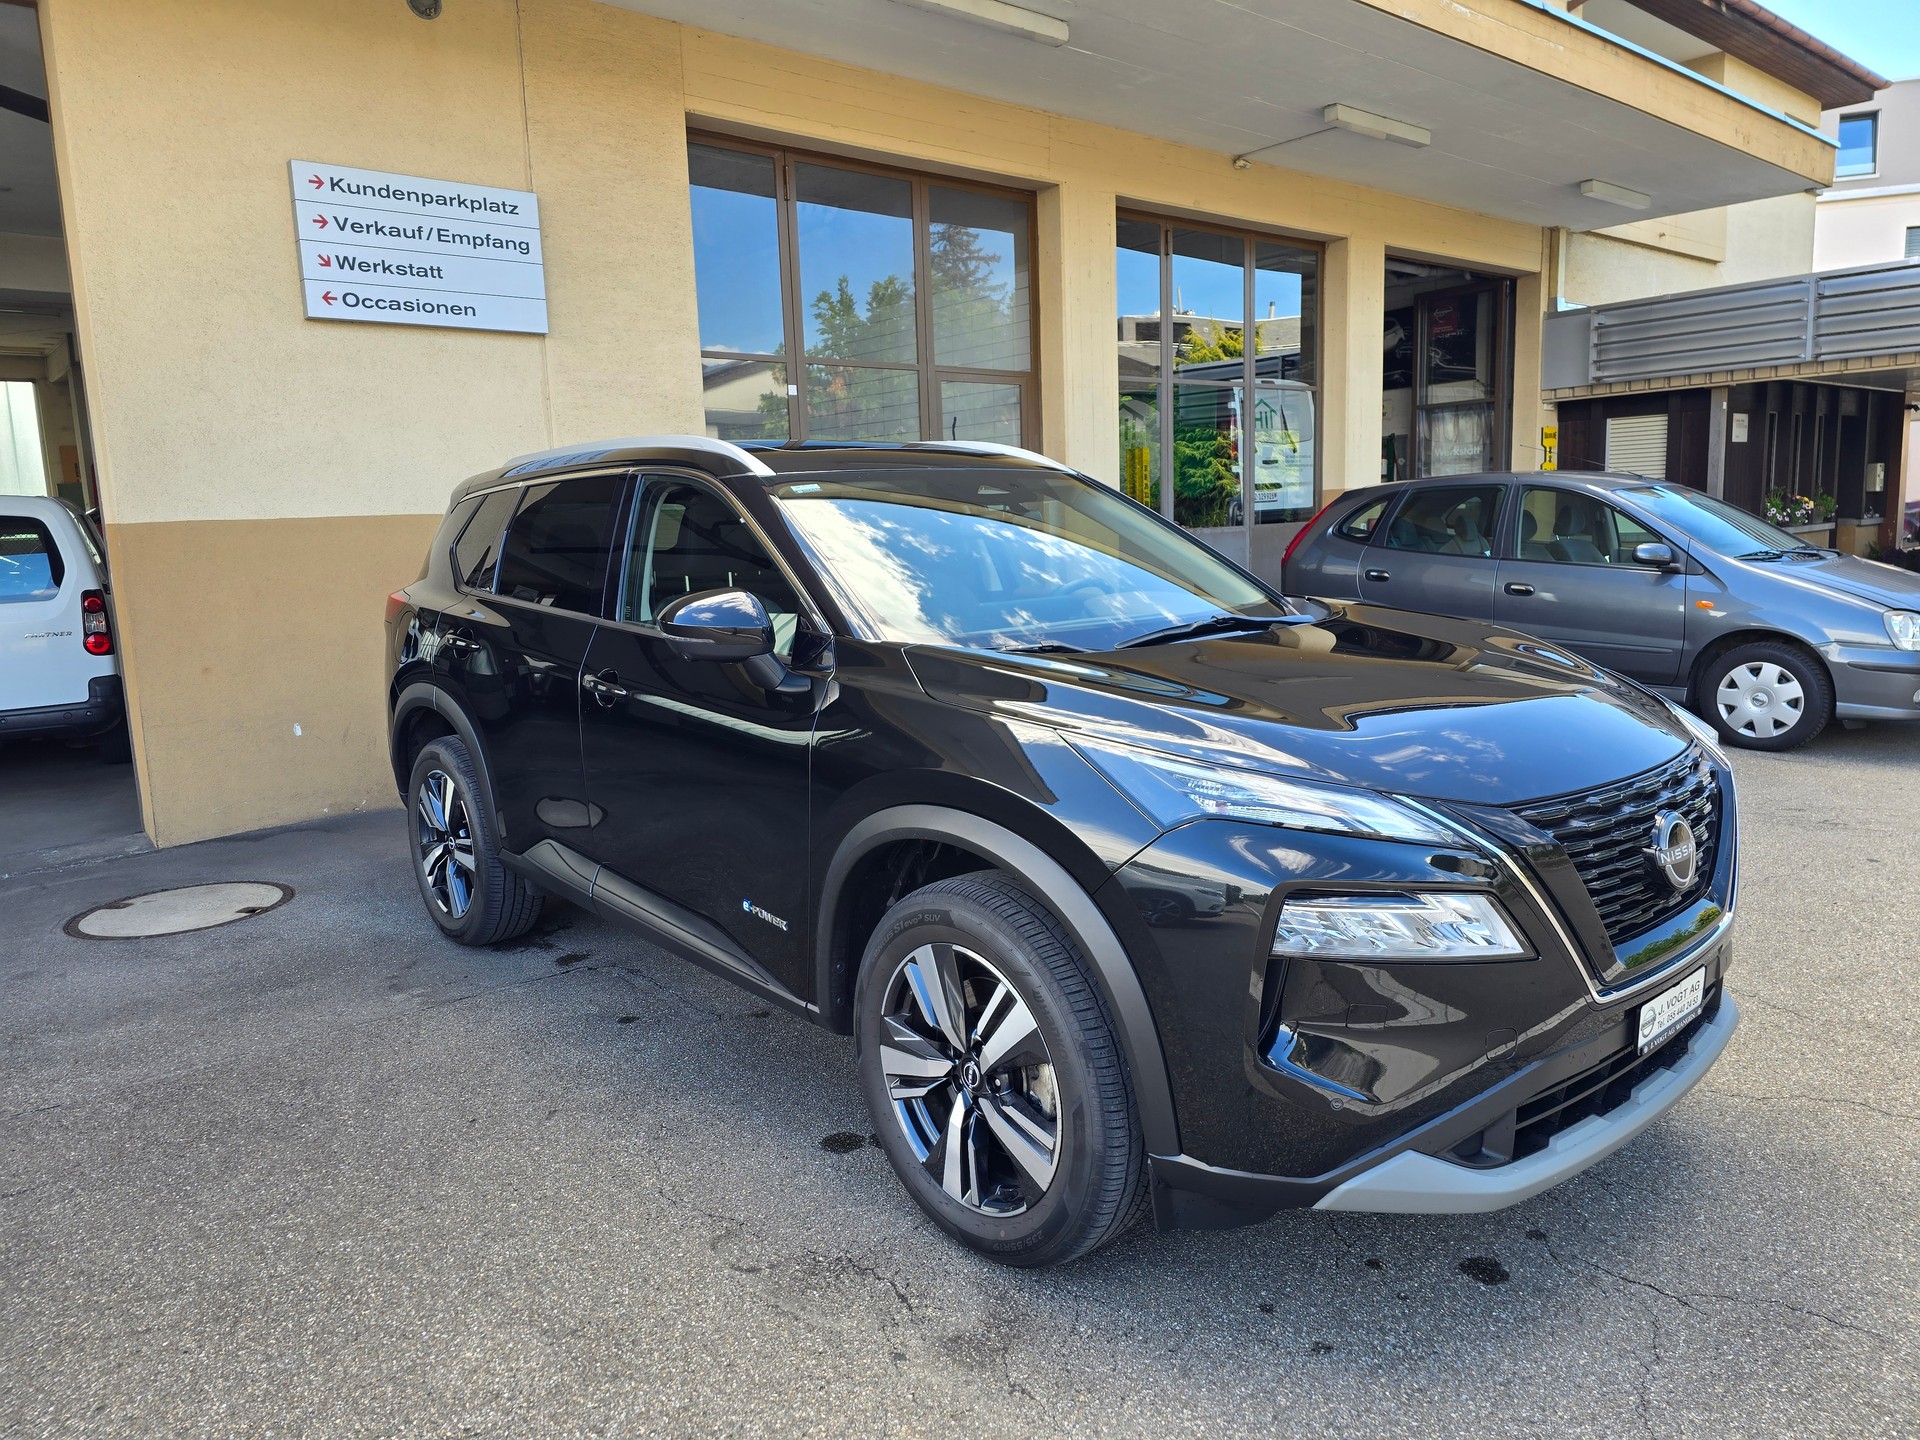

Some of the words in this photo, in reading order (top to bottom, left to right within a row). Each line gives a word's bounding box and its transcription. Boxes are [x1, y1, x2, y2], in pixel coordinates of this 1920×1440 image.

[330, 177, 519, 215] Kundenparkplatz
[333, 215, 530, 254] Verkauf/Empfang
[335, 255, 444, 279] Werkstatt
[342, 293, 477, 317] Occasionen
[1434, 445, 1480, 457] Werkstatt
[924, 914, 941, 922] SUV
[1667, 988, 1688, 1009] VOGT
[1689, 980, 1700, 995] AG
